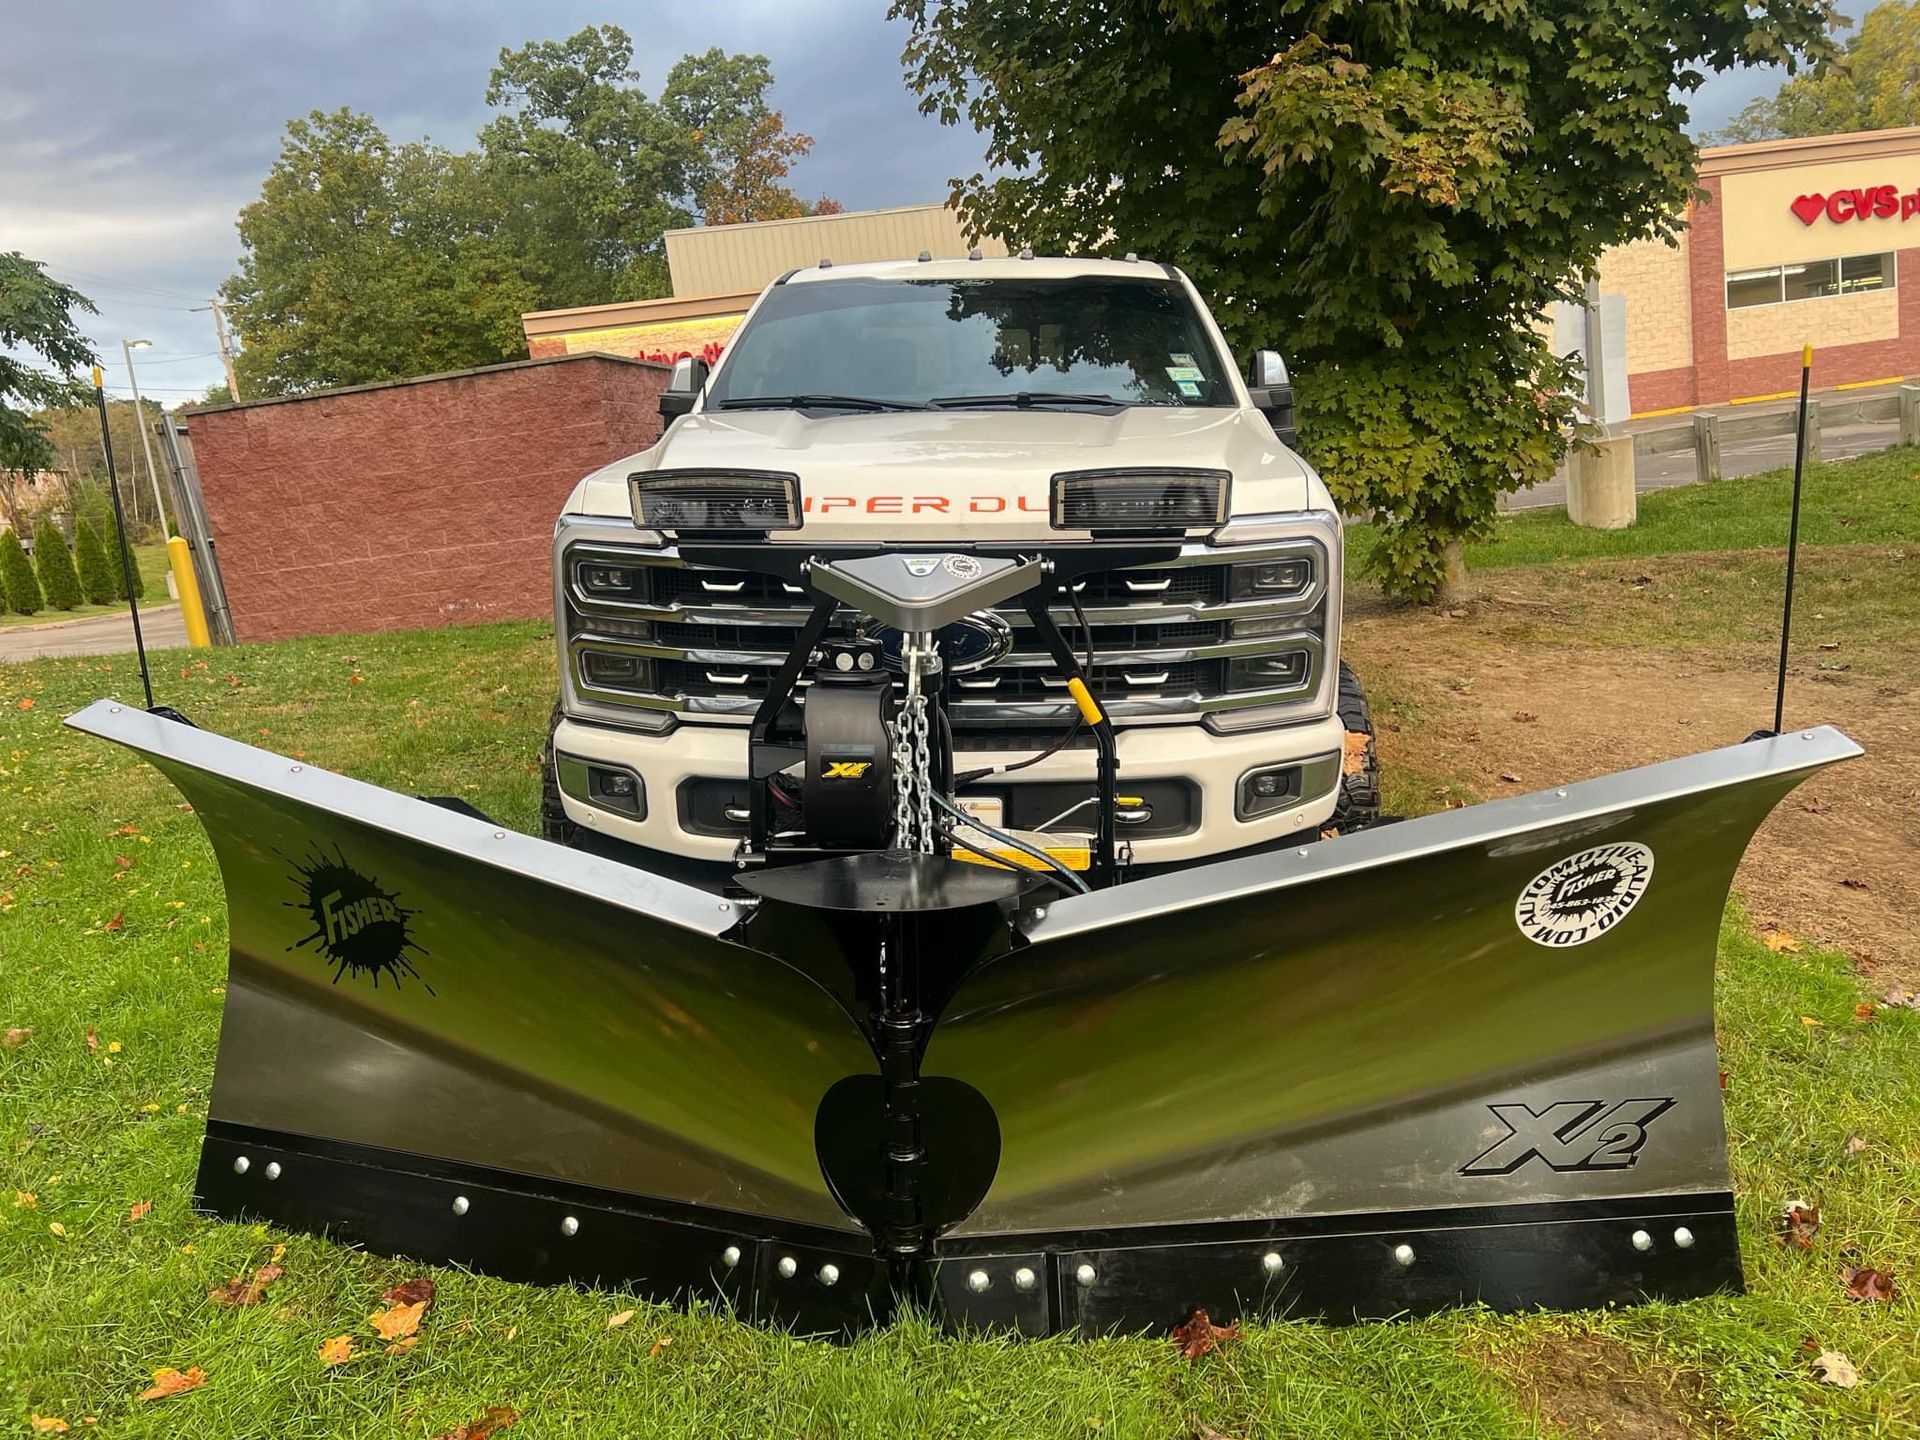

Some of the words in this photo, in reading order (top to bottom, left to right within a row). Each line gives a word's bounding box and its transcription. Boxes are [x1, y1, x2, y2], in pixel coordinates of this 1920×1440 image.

[1826, 184, 1899, 224] CVS
[803, 496, 950, 514] PER
[969, 496, 1050, 513] DU
[1556, 868, 1617, 902] FISHER
[321, 890, 402, 946] FISHER
